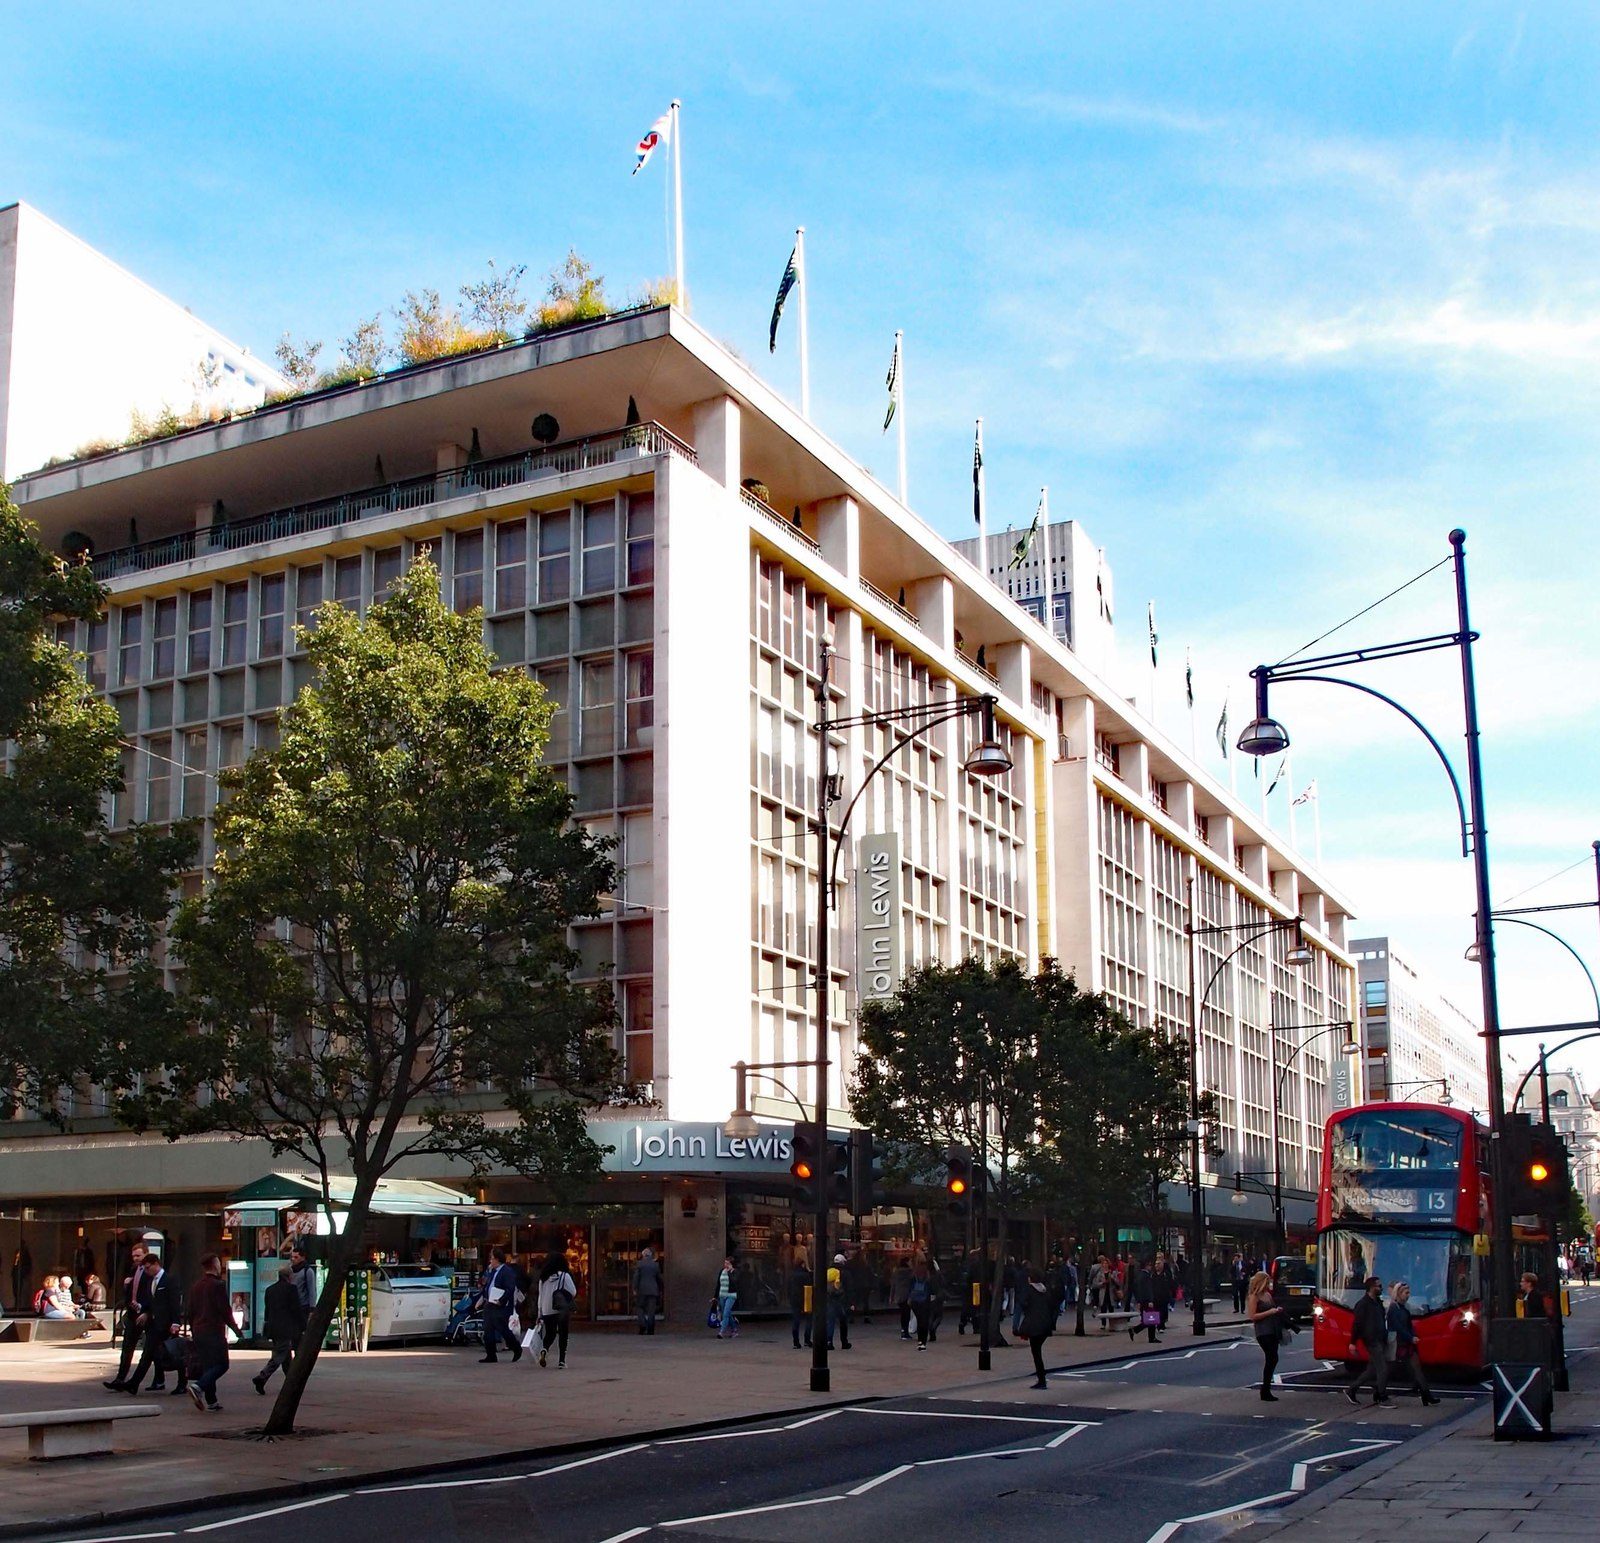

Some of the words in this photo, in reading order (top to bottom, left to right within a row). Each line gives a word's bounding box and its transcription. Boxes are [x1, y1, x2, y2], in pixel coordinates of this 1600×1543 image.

[864, 851, 891, 930] Lewis
[864, 936, 893, 1000] John
[1333, 1070, 1347, 1108] Lewis
[632, 1126, 706, 1166] John
[716, 1126, 791, 1160] Lewis
[1428, 1192, 1446, 1210] 13
